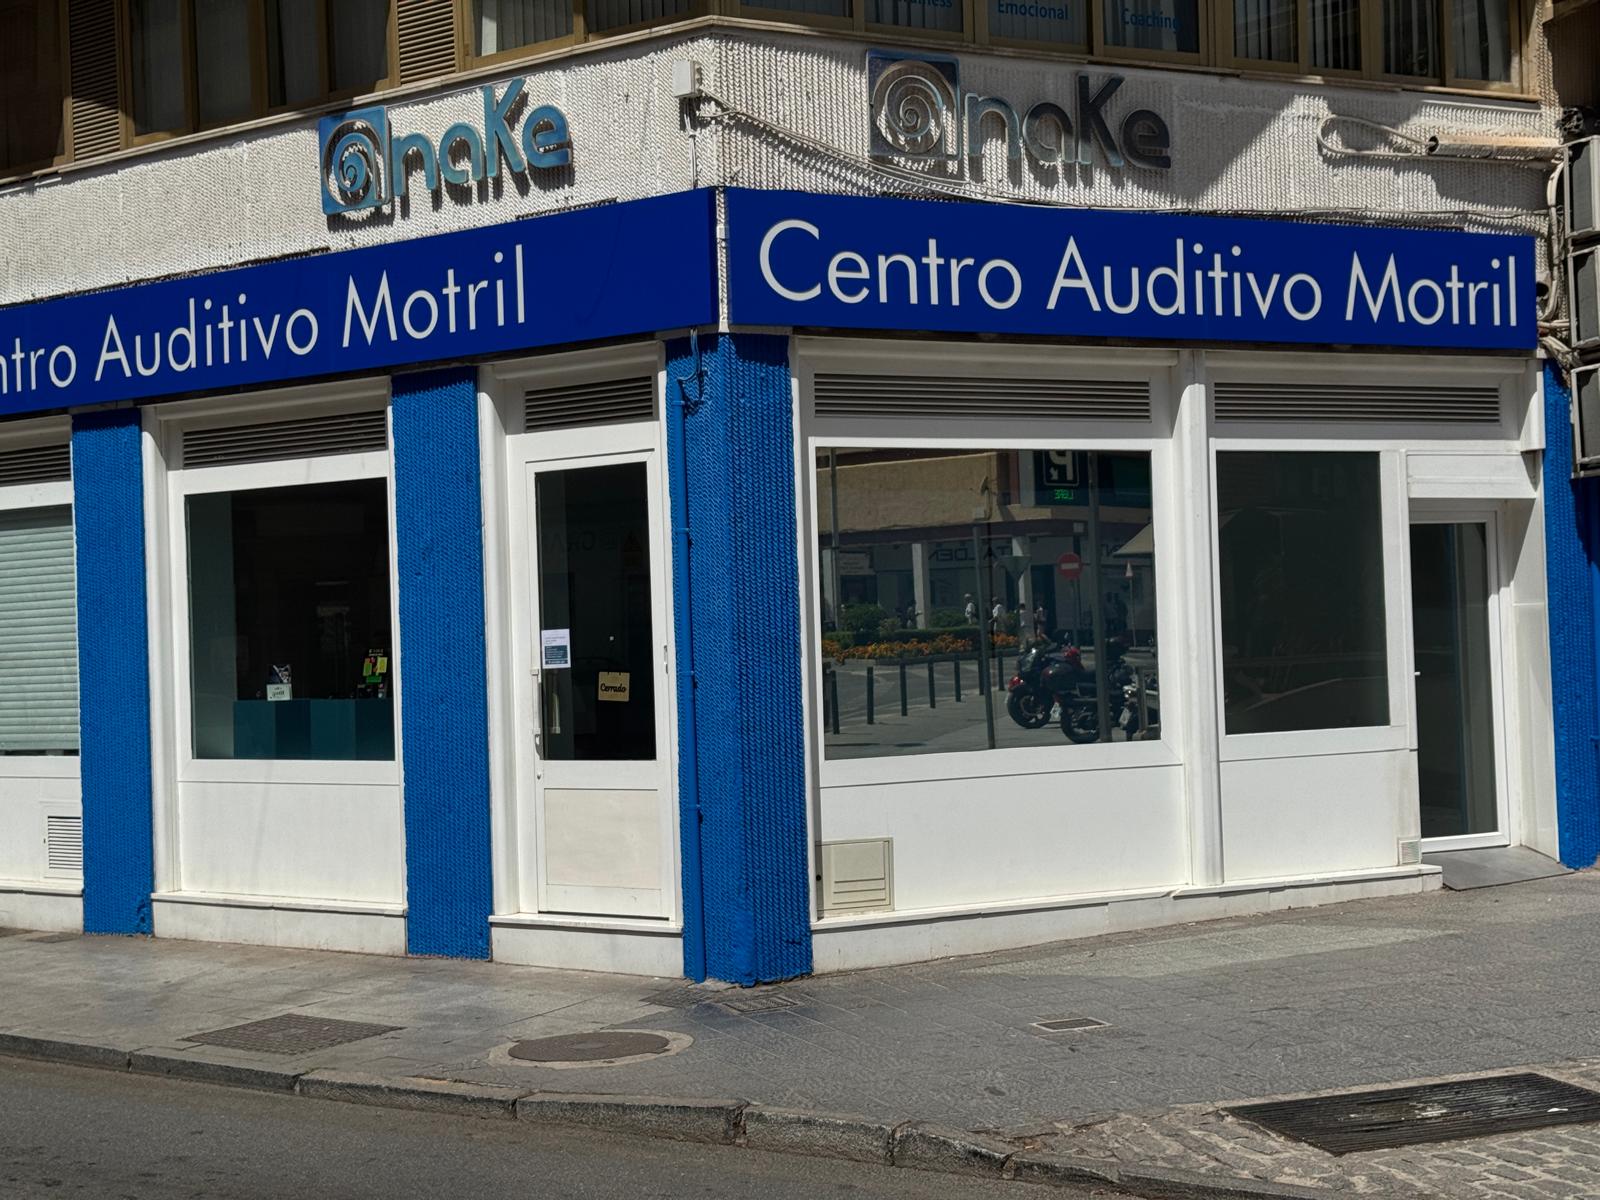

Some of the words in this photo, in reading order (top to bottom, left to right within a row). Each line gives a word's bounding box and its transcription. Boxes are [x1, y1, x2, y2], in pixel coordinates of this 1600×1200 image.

[998, 0, 1069, 21] Emocional
[1120, 8, 1183, 34] Coaching
[760, 219, 1022, 310] Centro
[1046, 235, 1322, 321] Auditivo
[1345, 251, 1517, 327] Motril
[95, 293, 319, 382] Auditivo
[343, 244, 525, 348] Motril
[600, 682, 627, 693] Cerrado
